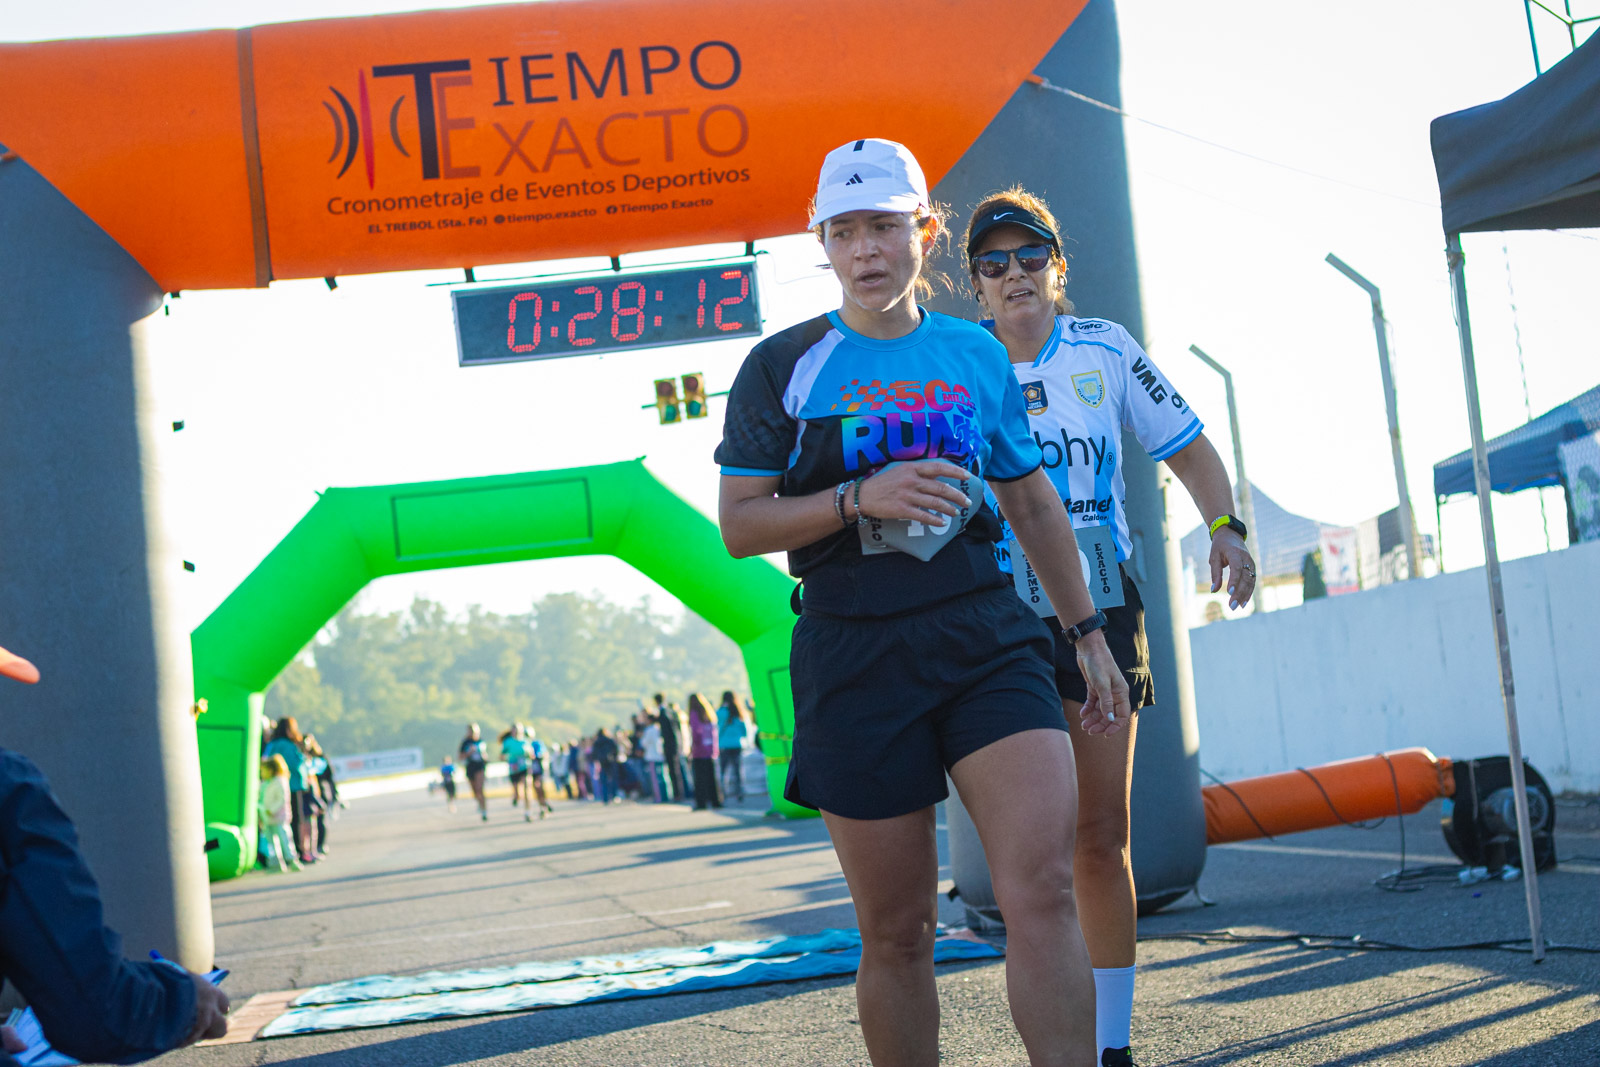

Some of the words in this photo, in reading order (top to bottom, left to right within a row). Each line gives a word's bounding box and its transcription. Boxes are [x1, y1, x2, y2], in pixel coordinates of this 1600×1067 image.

[327, 186, 484, 215] Cronometraje
[490, 184, 519, 203] de
[525, 179, 616, 201] Eventos
[623, 167, 750, 193] Deportivos
[368, 224, 382, 234] EL
[387, 220, 435, 232] TREBOL
[437, 217, 466, 230] (Sta.
[468, 215, 488, 227] Fe)
[507, 206, 597, 224] tiempo.exacto
[620, 201, 669, 215] Tiempo
[671, 197, 714, 210] Exacto
[1131, 356, 1168, 405] VMG
[1094, 543, 1111, 594] EXACTO
